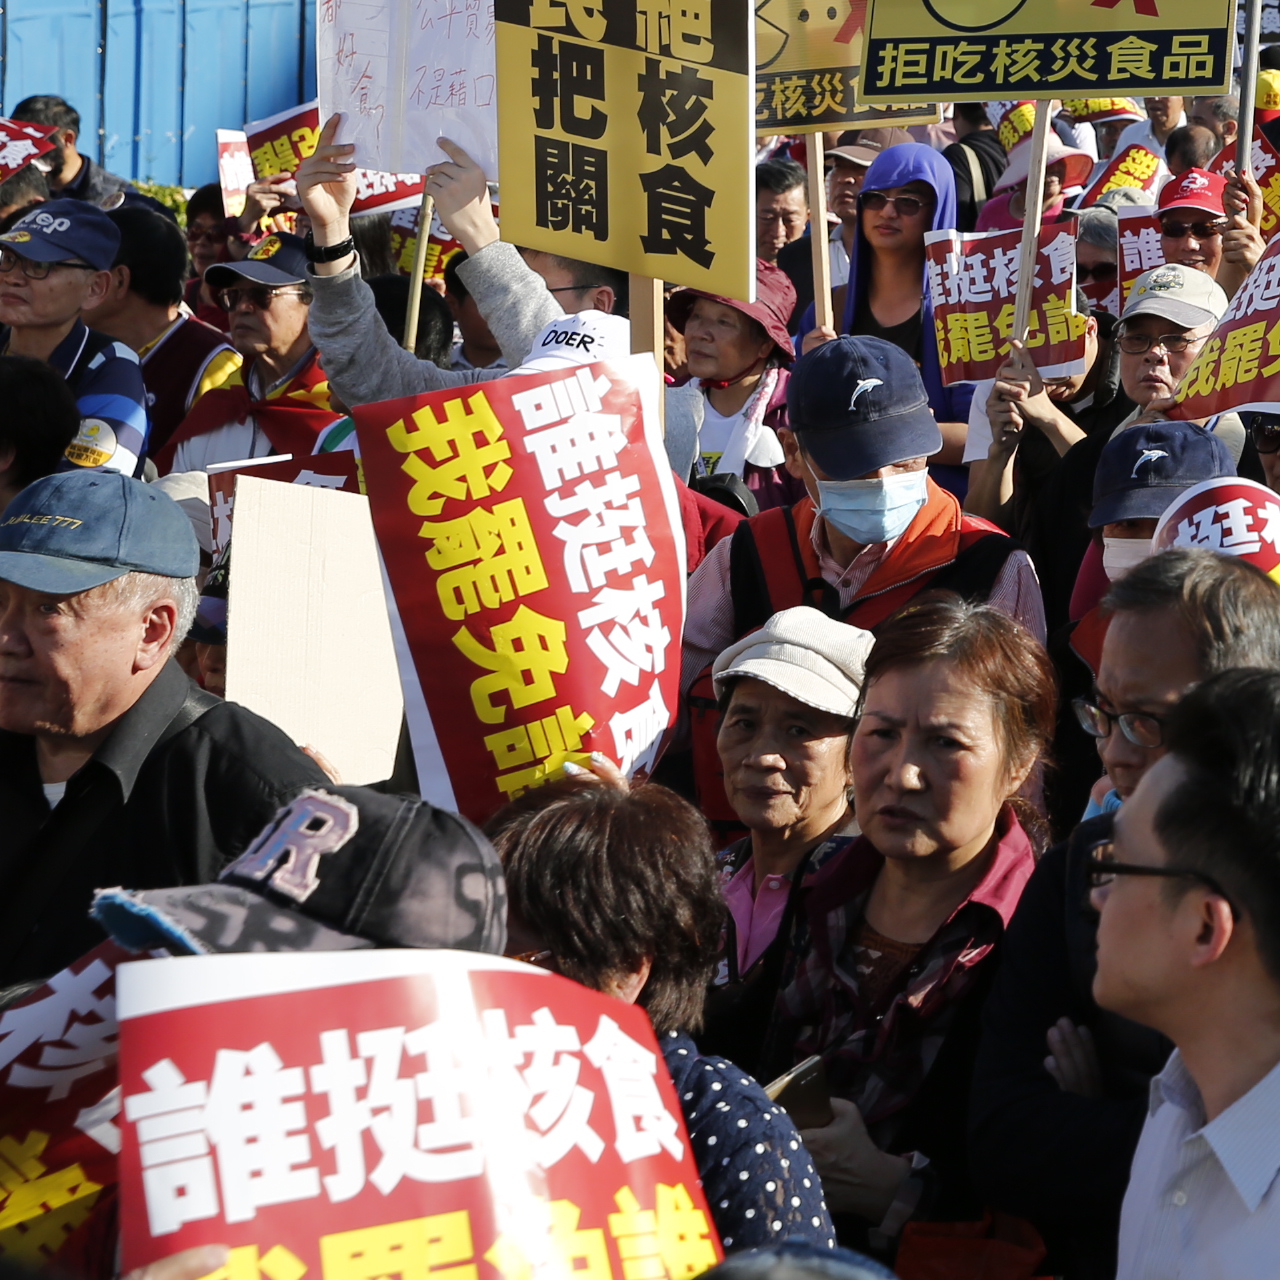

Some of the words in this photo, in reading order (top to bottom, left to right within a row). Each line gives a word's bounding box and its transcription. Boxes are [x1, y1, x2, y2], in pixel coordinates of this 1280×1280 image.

[876, 34, 1215, 88] 拒吃核災食品
[410, 66, 496, 108] 不是藉口
[541, 329, 596, 353] DOER
[51, 515, 84, 530] 777
[222, 788, 359, 903] R
[124, 1006, 684, 1238] 誰挺核食
